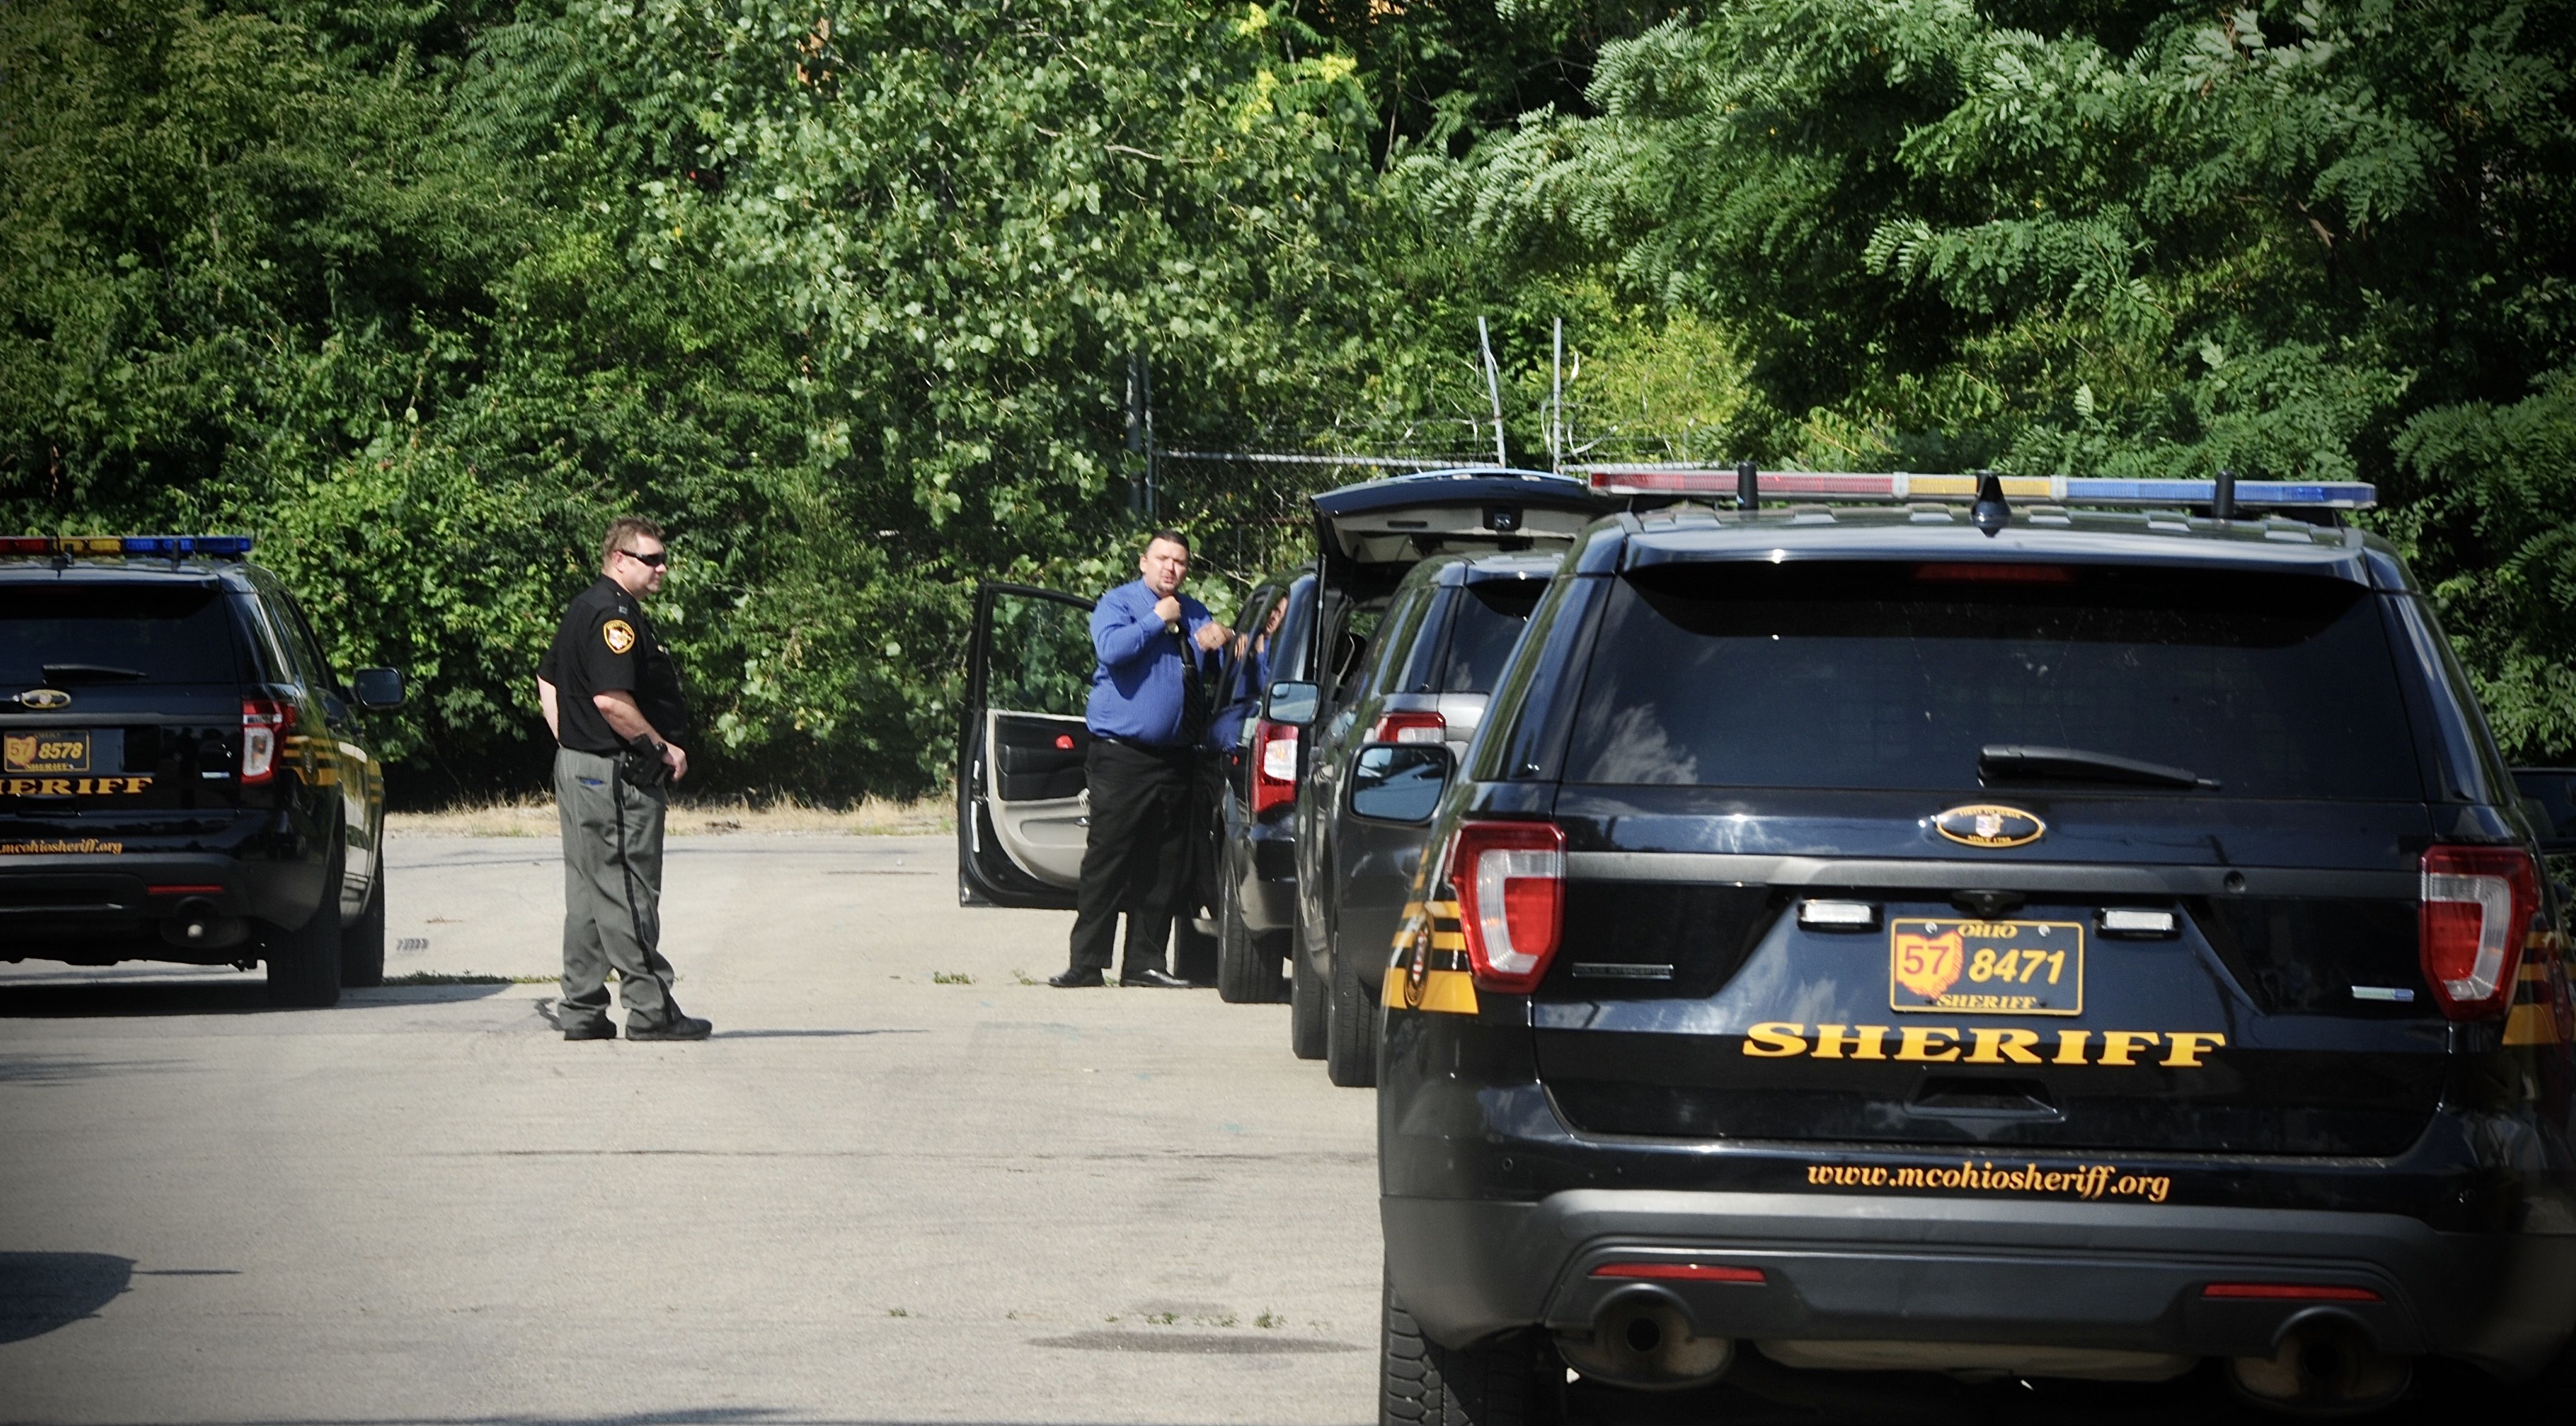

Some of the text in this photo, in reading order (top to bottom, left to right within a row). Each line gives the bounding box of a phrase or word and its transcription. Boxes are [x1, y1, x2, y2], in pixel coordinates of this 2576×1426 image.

[10, 741, 84, 759] 57 8578
[0, 777, 153, 795] ERIFF
[1958, 923, 2018, 939] OHIO
[1902, 945, 2066, 985] 57 8471
[1937, 994, 2036, 1009] SHERIFF
[1743, 1022, 2227, 1067] SHERIFF
[1807, 1161, 2170, 1204] www.mcohiosheriff.org
